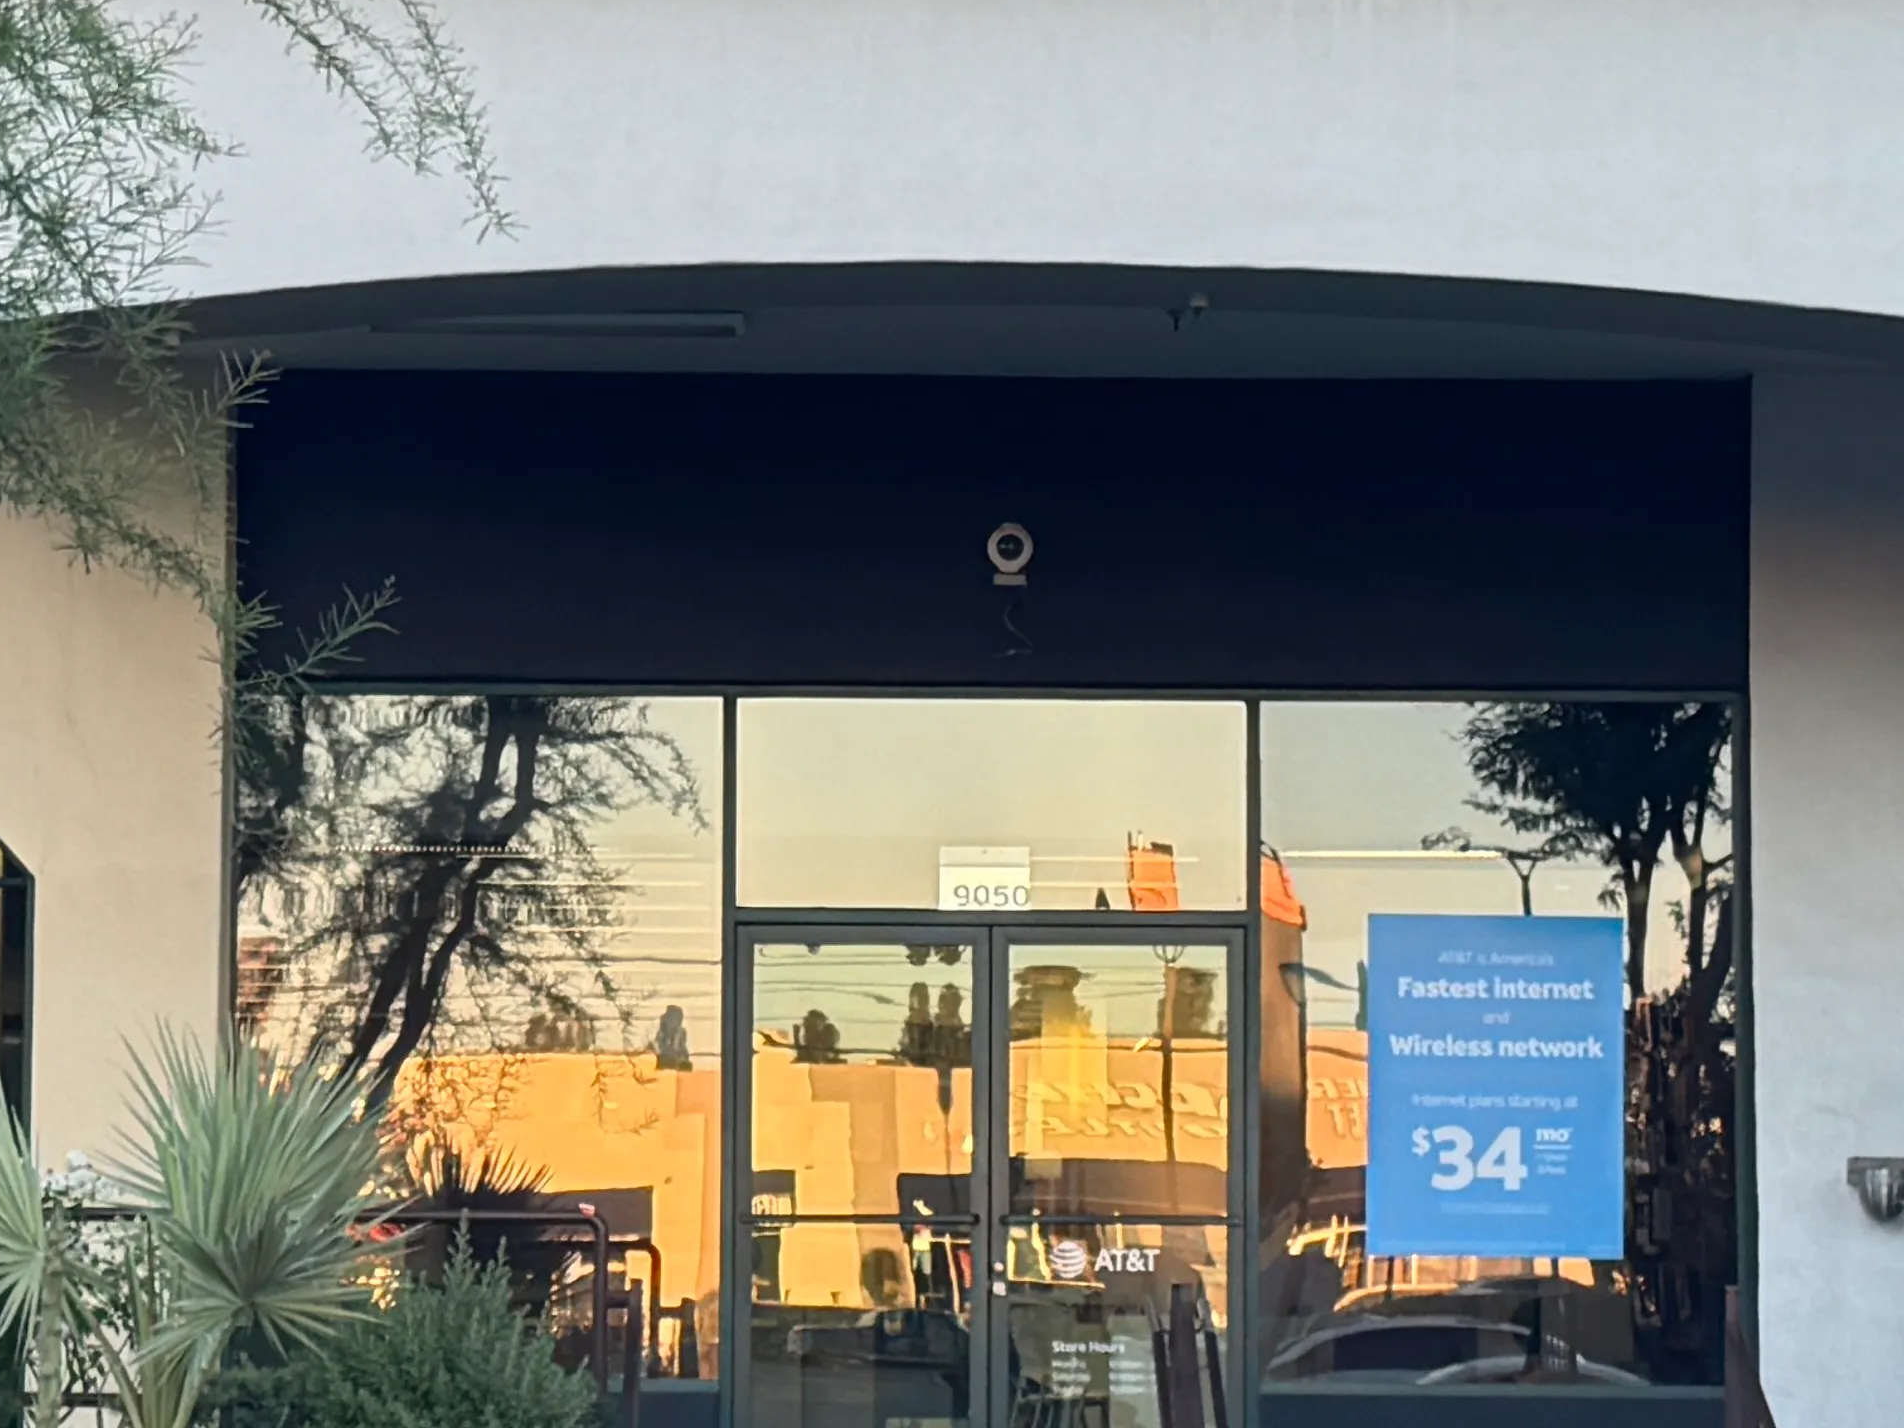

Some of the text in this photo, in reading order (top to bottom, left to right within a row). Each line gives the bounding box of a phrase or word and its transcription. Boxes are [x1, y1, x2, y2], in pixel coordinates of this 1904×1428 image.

[953, 884, 1029, 907] 9050
[1397, 975, 1595, 1000] Fastest internet
[1482, 1010, 1512, 1024] and
[1389, 1033, 1604, 1059] Wireless network
[1411, 1125, 1529, 1192] $34
[1095, 1248, 1160, 1272] AT&T
